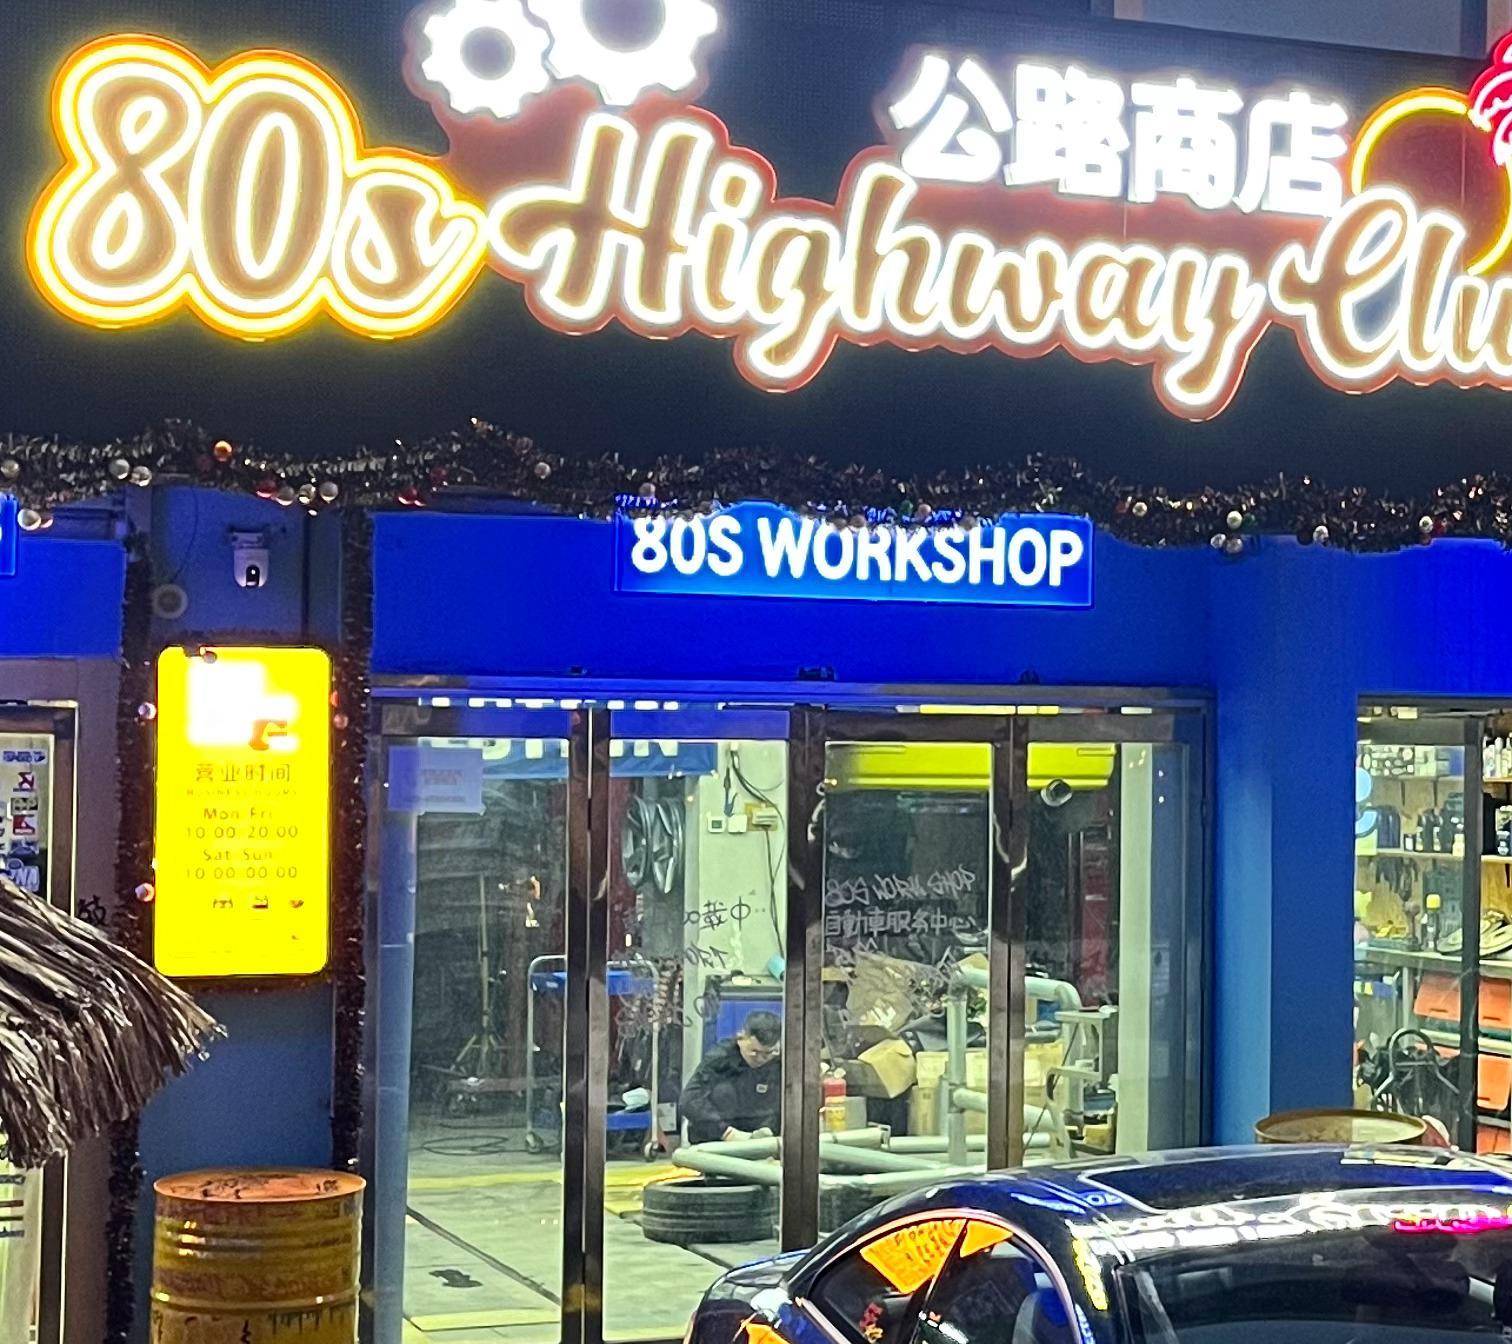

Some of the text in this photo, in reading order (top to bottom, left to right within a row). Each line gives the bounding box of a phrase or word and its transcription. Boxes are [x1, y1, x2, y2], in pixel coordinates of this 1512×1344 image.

[890, 51, 1350, 218] 公路商店
[53, 56, 489, 315] 80s
[488, 111, 1266, 408] Highway
[631, 515, 1083, 587] 80S WORKSHOP
[196, 763, 290, 782] 营业时间
